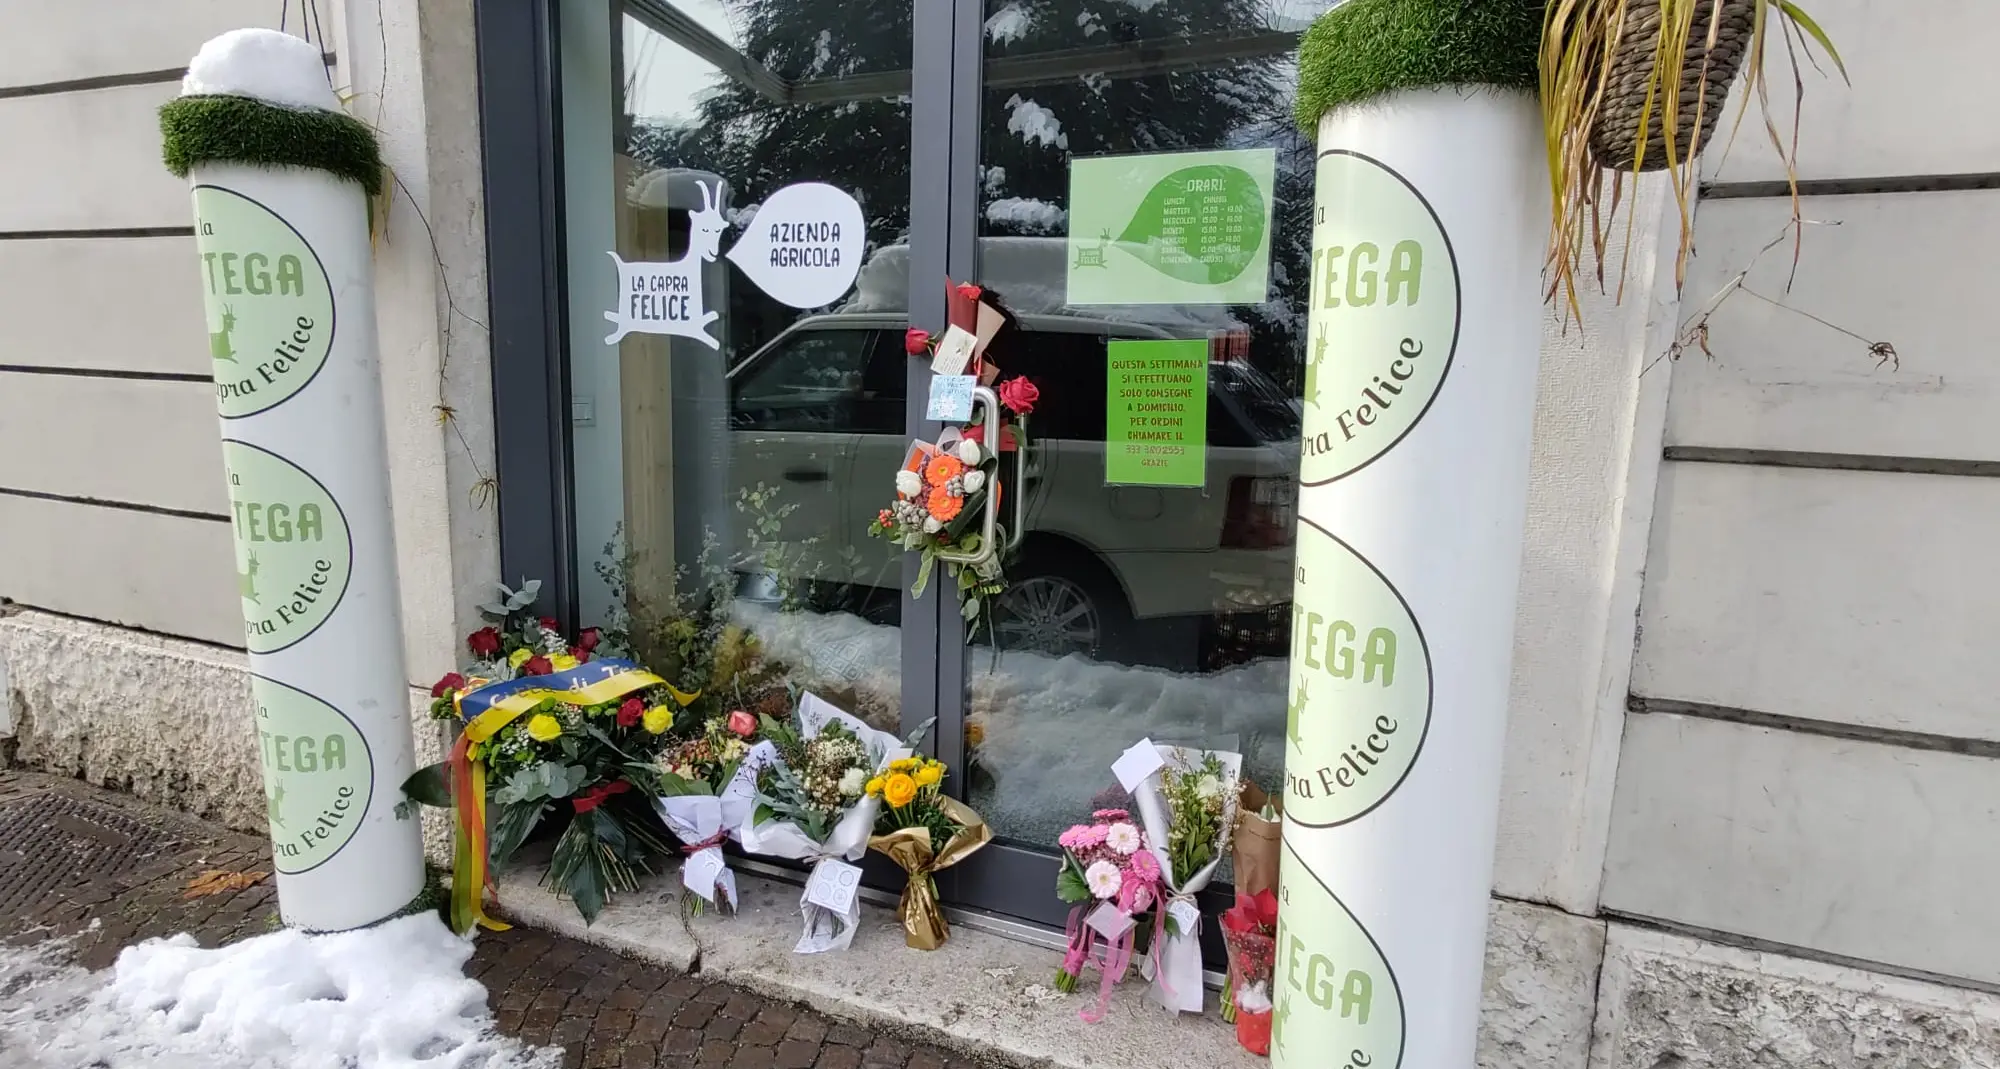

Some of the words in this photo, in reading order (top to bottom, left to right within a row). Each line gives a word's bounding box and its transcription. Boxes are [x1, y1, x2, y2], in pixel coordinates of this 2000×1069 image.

[1314, 202, 1326, 227] la
[198, 217, 214, 236] la
[769, 222, 841, 243] AZIENDA
[770, 247, 840, 268] AGRICOLA
[631, 275, 645, 292] LA
[650, 275, 689, 292] CAPRA
[630, 294, 691, 321] FELICE
[256, 315, 315, 385] Felice
[1111, 360, 1147, 370] QUESTA
[1149, 359, 1203, 369] SETTIMANA
[1121, 374, 1131, 384] SI
[1134, 374, 1193, 384] EFFETTUANO
[1335, 337, 1424, 442] Felice
[1119, 388, 1142, 398] SOLO
[1145, 388, 1193, 398] CONSEGNE
[1127, 402, 1133, 412] A
[1130, 417, 1147, 427] PER
[1150, 417, 1183, 427] ORDINI
[1127, 431, 1172, 441] CHIAMARE
[1175, 431, 1184, 441] IL
[227, 466, 241, 486] la
[1295, 557, 1306, 585] la
[276, 559, 332, 626] Felice
[256, 699, 269, 720] la
[1316, 715, 1398, 797] Felice
[300, 786, 354, 850] Felice
